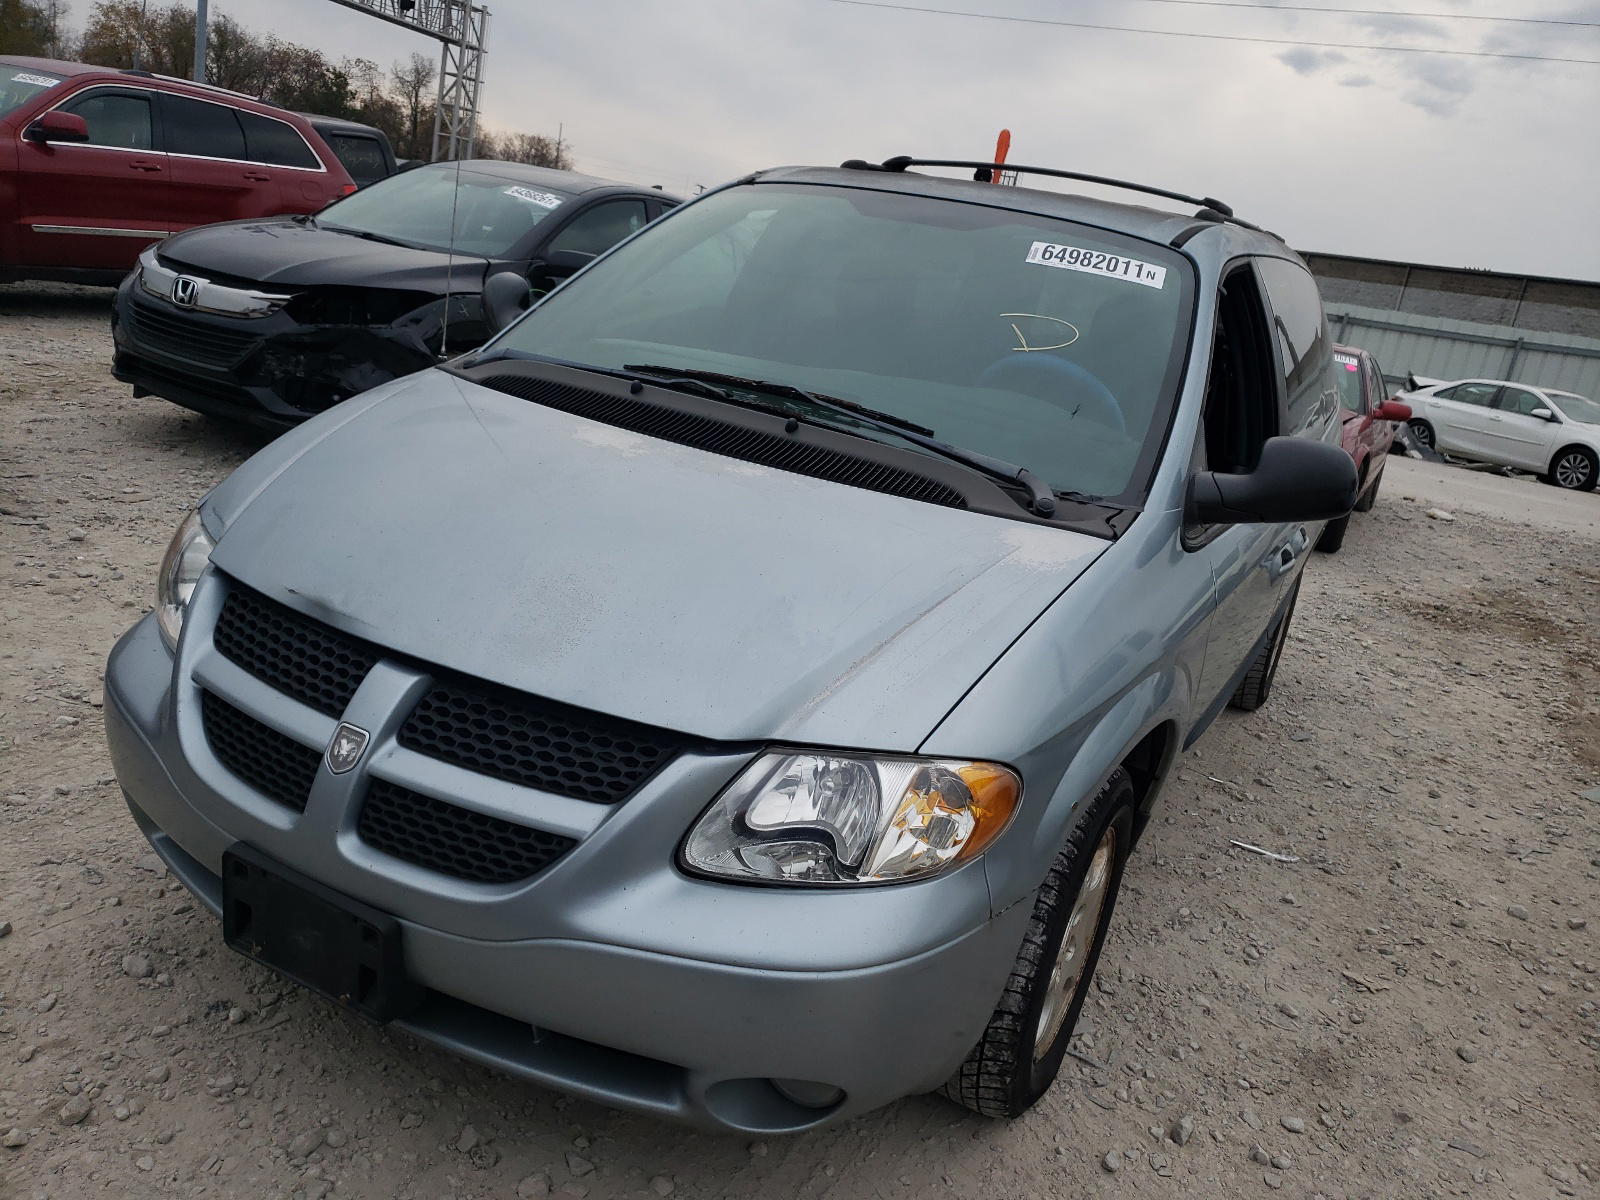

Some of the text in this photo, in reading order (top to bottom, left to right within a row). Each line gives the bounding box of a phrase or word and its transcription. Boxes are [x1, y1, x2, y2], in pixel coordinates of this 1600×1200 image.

[1041, 244, 1144, 278] 64982011
[1146, 270, 1156, 281] N
[1000, 313, 1079, 353] D
